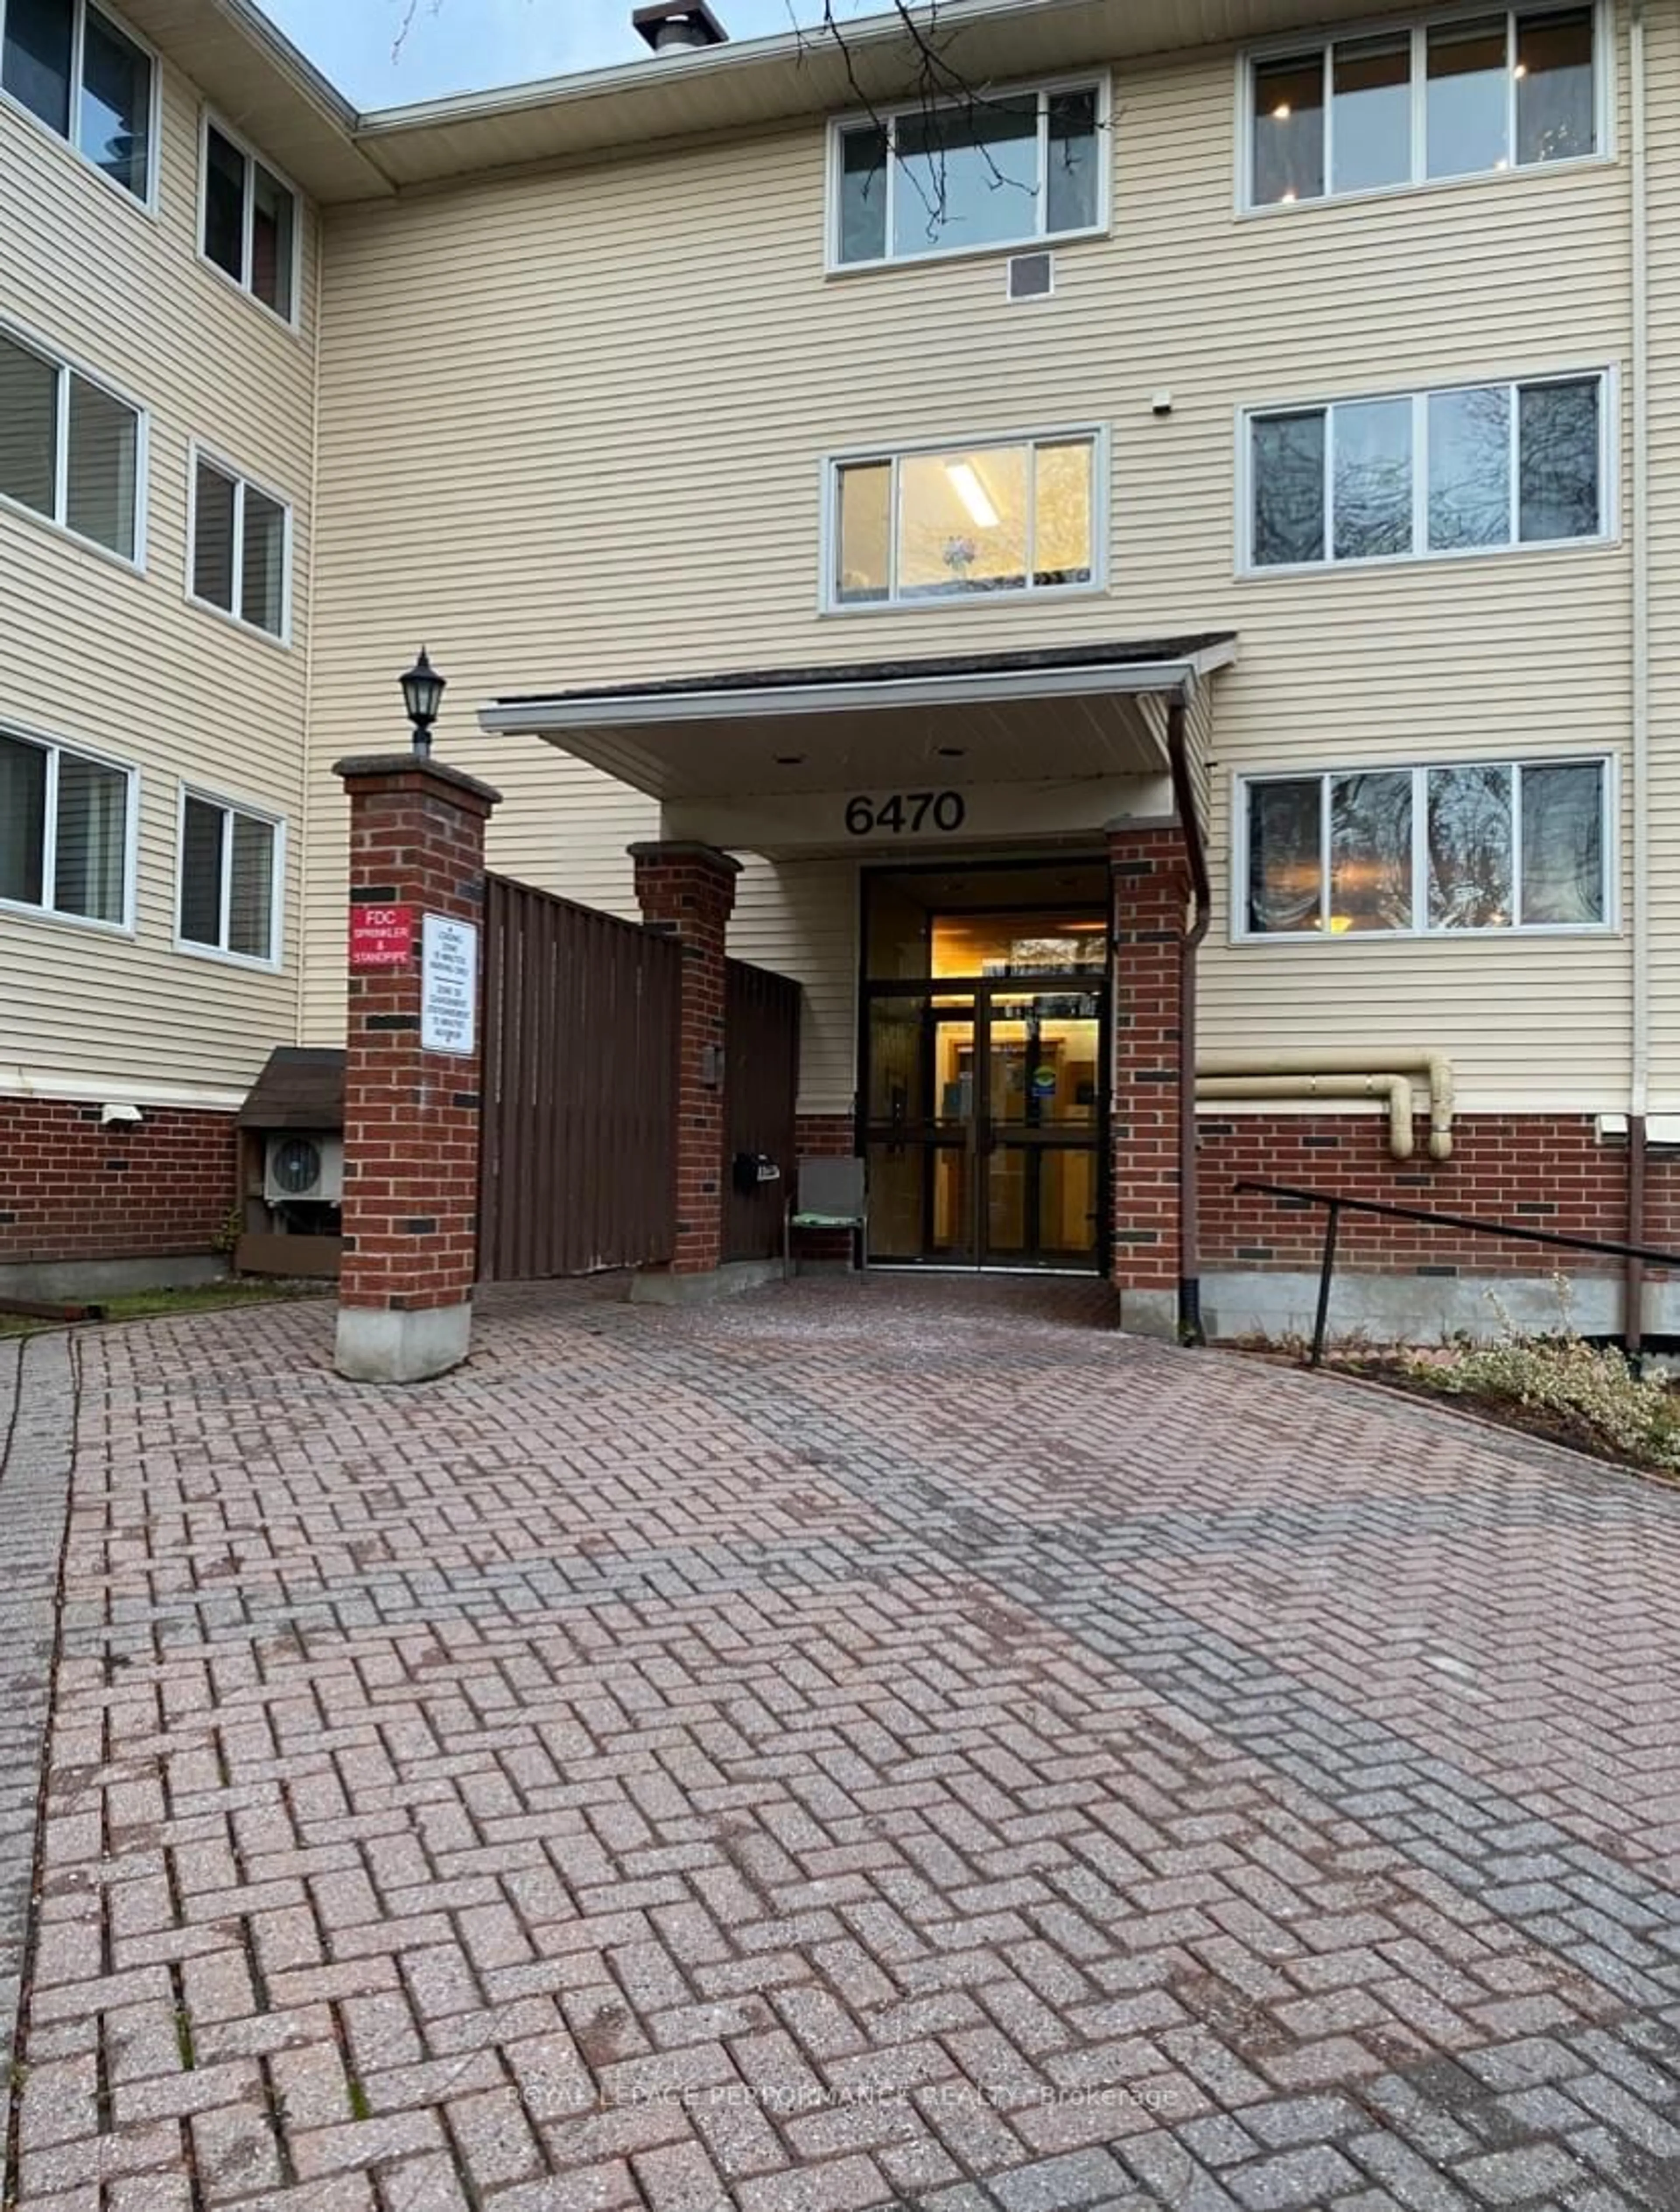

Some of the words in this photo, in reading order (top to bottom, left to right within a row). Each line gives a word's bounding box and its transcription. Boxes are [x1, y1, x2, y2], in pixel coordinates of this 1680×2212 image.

[845, 790, 966, 835] 6470
[365, 911, 397, 926] FDC
[353, 951, 407, 964] STANDPIPE
